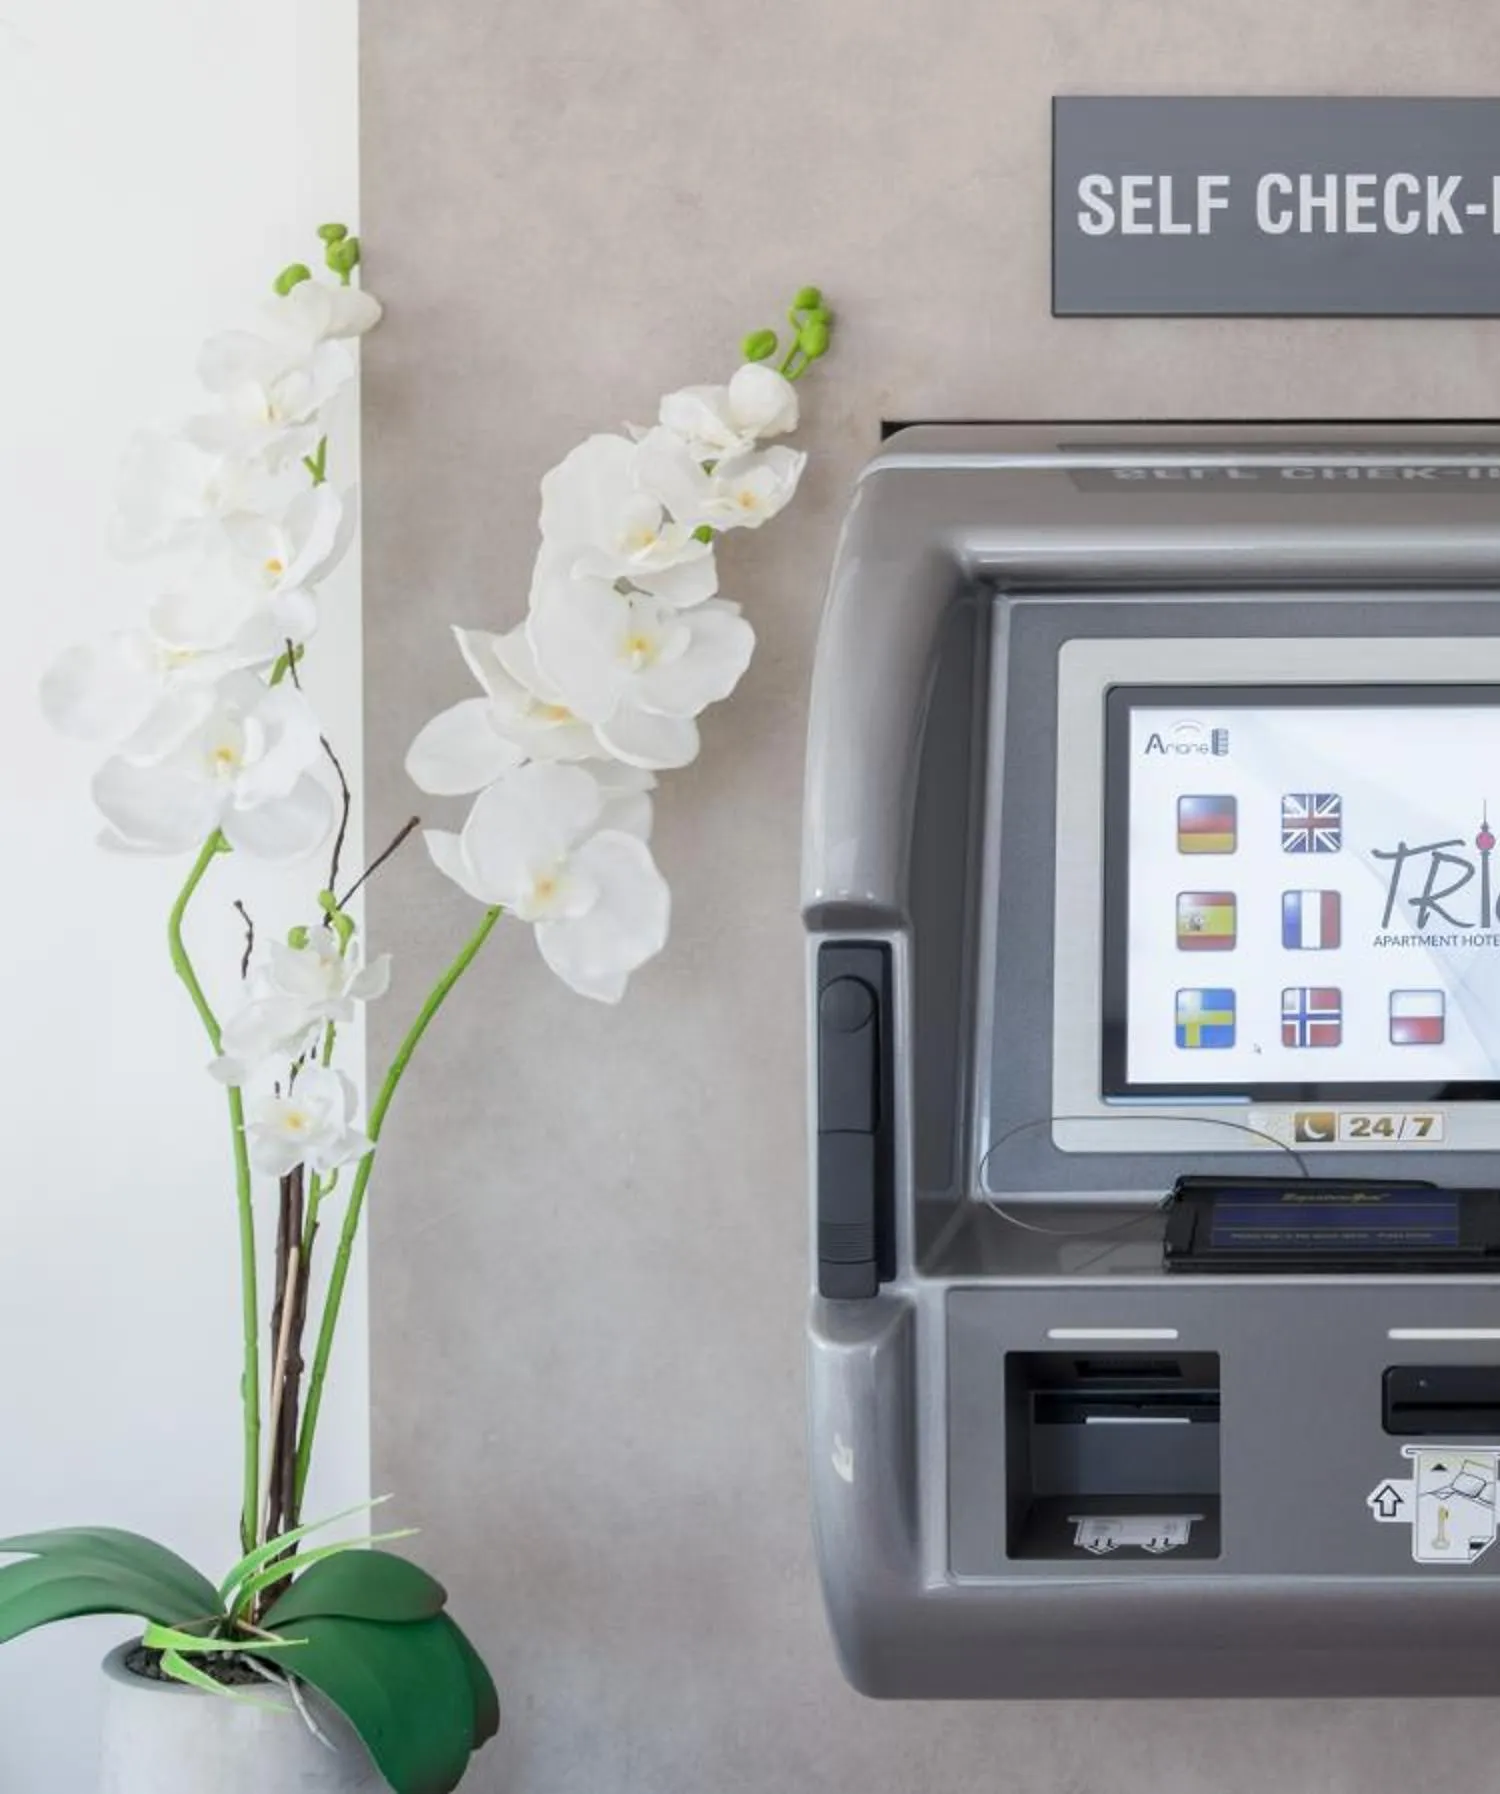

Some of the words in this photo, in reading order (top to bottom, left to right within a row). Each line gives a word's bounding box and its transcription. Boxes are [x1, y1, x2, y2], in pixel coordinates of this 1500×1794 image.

[1077, 174, 1230, 235] SELF
[1373, 934, 1458, 947] APARTMENT
[1349, 1116, 1435, 1143] 24/7
